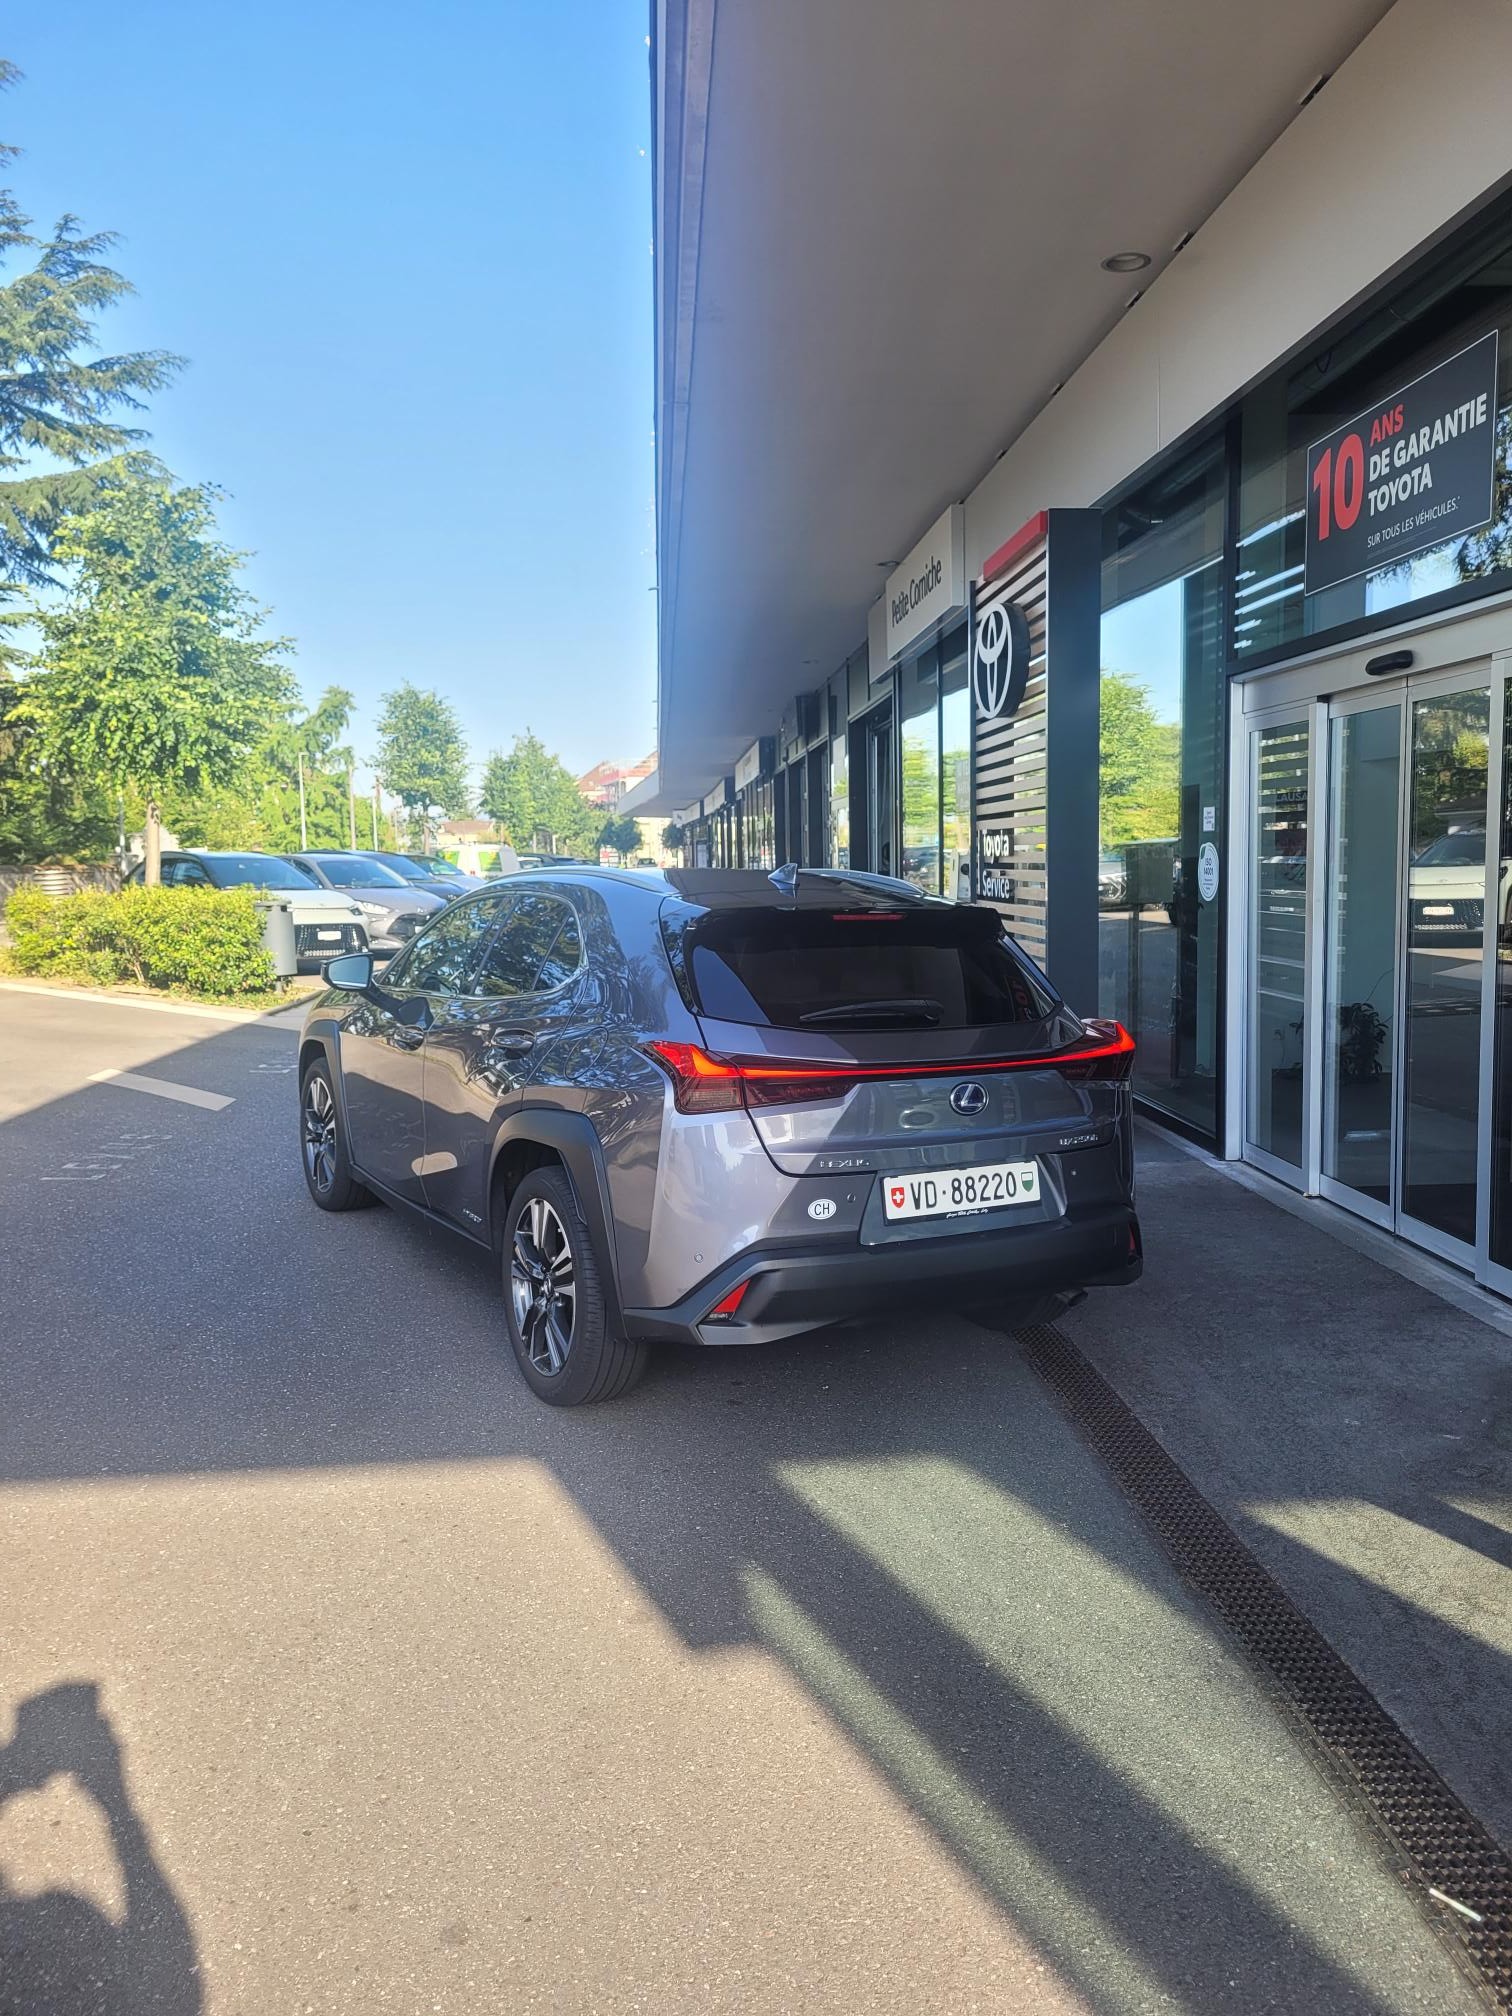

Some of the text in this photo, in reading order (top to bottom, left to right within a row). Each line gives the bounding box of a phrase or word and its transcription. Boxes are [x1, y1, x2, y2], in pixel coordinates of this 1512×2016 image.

[1369, 392, 1488, 482] DE GARANTIE
[1313, 403, 1404, 541] 10 ANS
[1368, 462, 1433, 517] TOYOTA
[1368, 532, 1381, 548] SUR
[1382, 523, 1401, 541] TOUS
[1402, 517, 1414, 533] LES
[891, 555, 942, 628] Petite Corniche
[982, 829, 1010, 864] Toyota
[982, 870, 1010, 899] Service
[814, 1203, 830, 1216] CH
